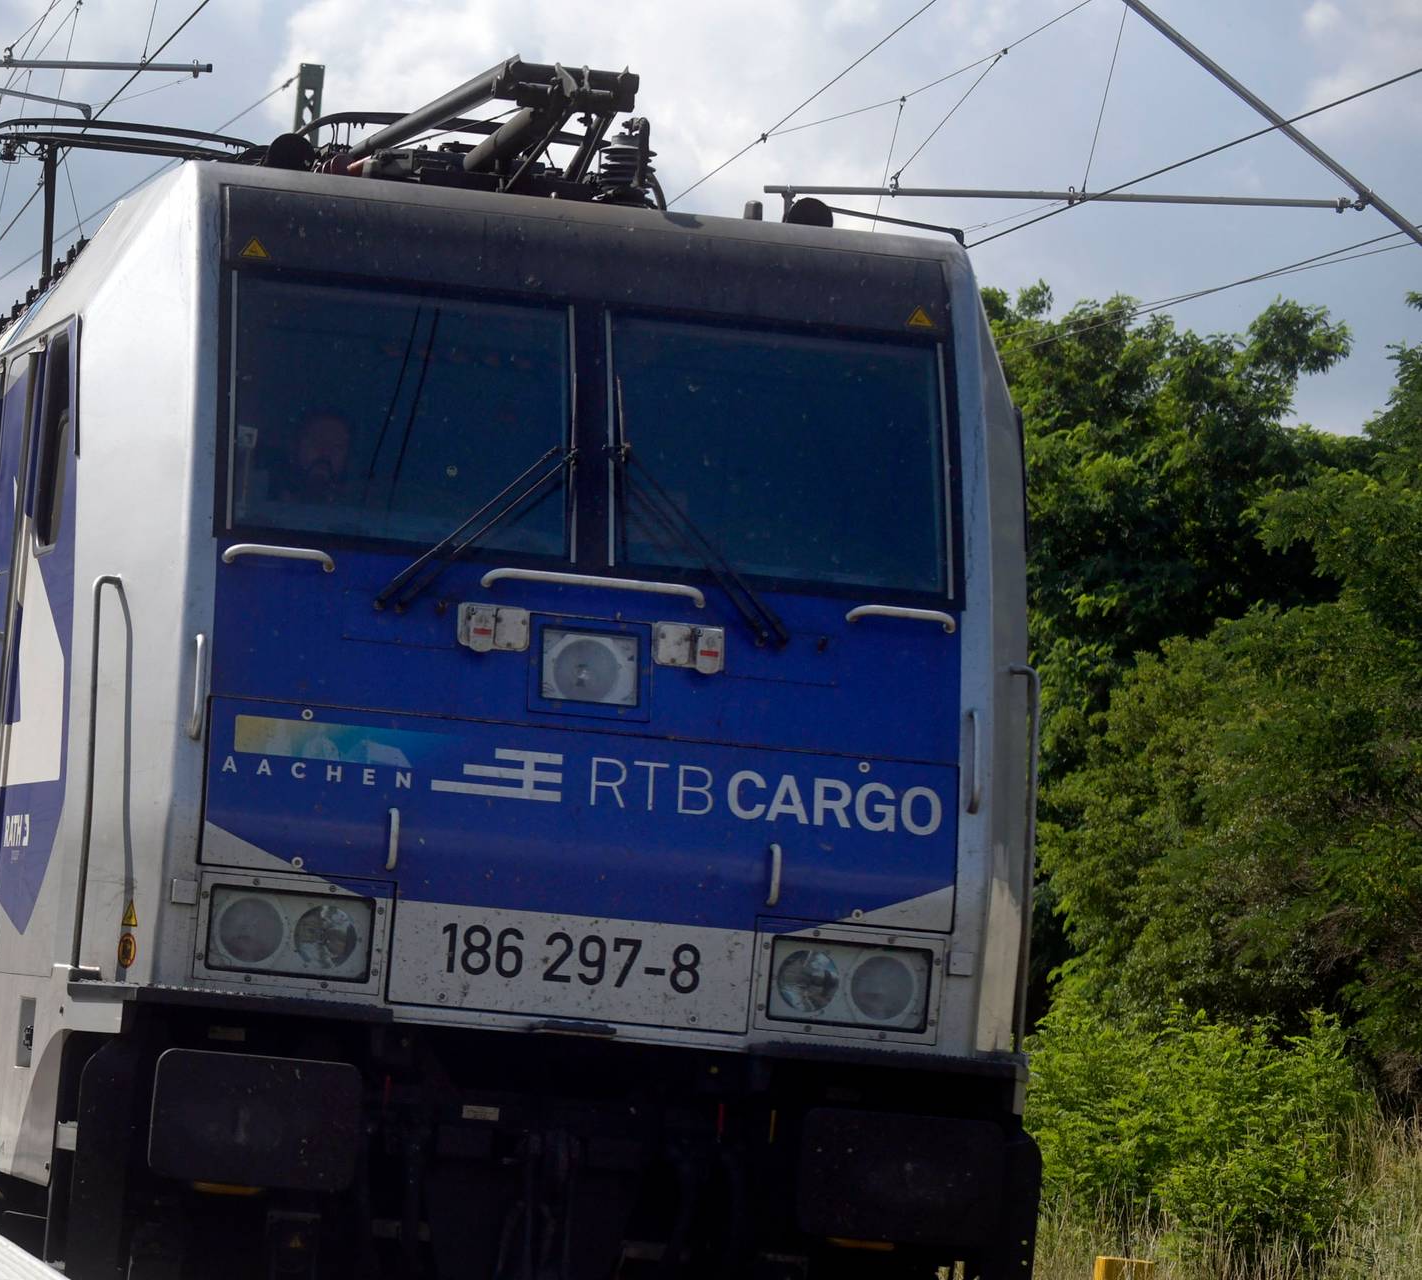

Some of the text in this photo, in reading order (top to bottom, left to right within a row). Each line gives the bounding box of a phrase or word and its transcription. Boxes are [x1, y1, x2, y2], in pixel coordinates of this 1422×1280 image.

[221, 755, 412, 790] AACHEN
[589, 756, 943, 837] RTB CARGO
[441, 922, 701, 995] 186 297-8
